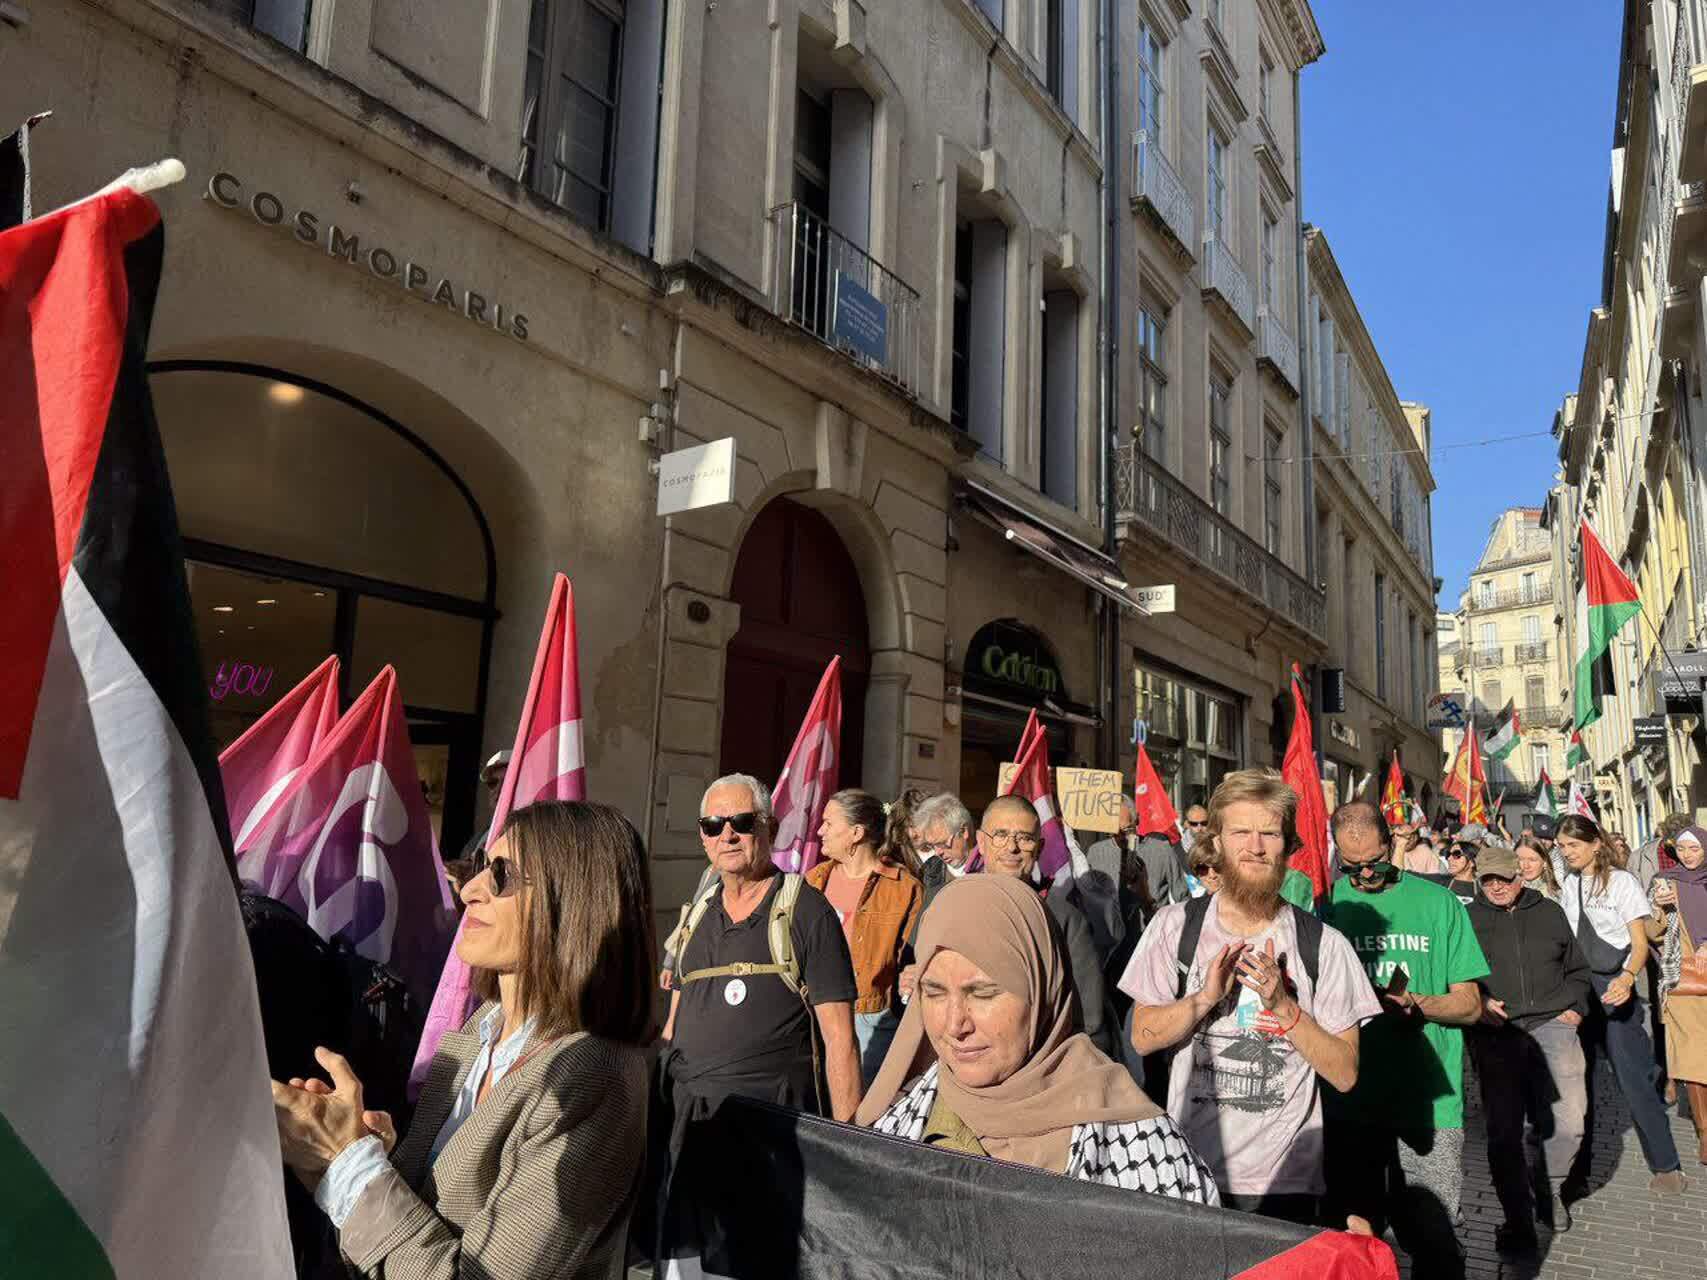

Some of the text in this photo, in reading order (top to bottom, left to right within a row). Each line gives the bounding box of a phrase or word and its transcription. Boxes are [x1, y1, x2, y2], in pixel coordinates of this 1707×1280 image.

[208, 172, 529, 340] COSMOPARIS
[1138, 591, 1162, 602] SUD
[1064, 771, 1116, 788] THEM
[1353, 933, 1430, 953] LESTINE
[1362, 960, 1411, 979] IVRA
